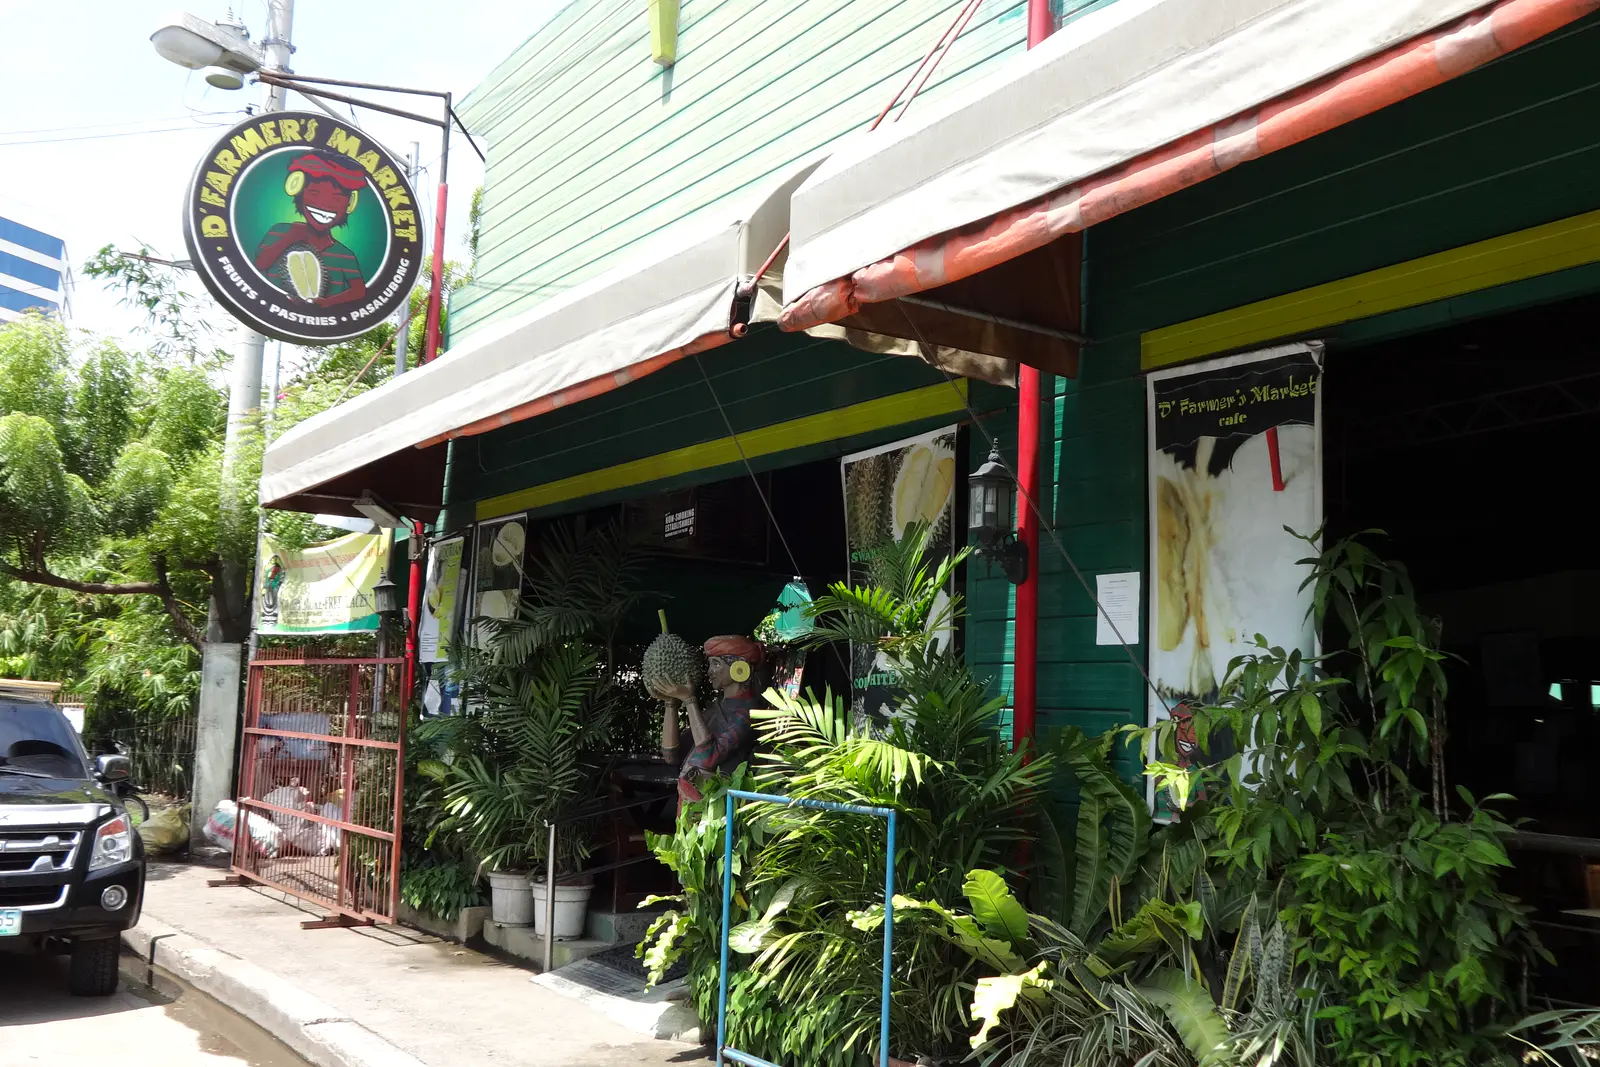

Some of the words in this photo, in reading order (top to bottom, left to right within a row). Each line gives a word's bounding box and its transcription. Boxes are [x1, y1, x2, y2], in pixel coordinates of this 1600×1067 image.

[326, 127, 417, 243] MARKET
[218, 255, 257, 300] FRUITS
[269, 303, 338, 326] PASTRIES
[351, 258, 410, 321] PASALUBONG
[1180, 389, 1247, 416] Farmer's
[1250, 374, 1317, 404] Market
[1218, 412, 1247, 427] cafe
